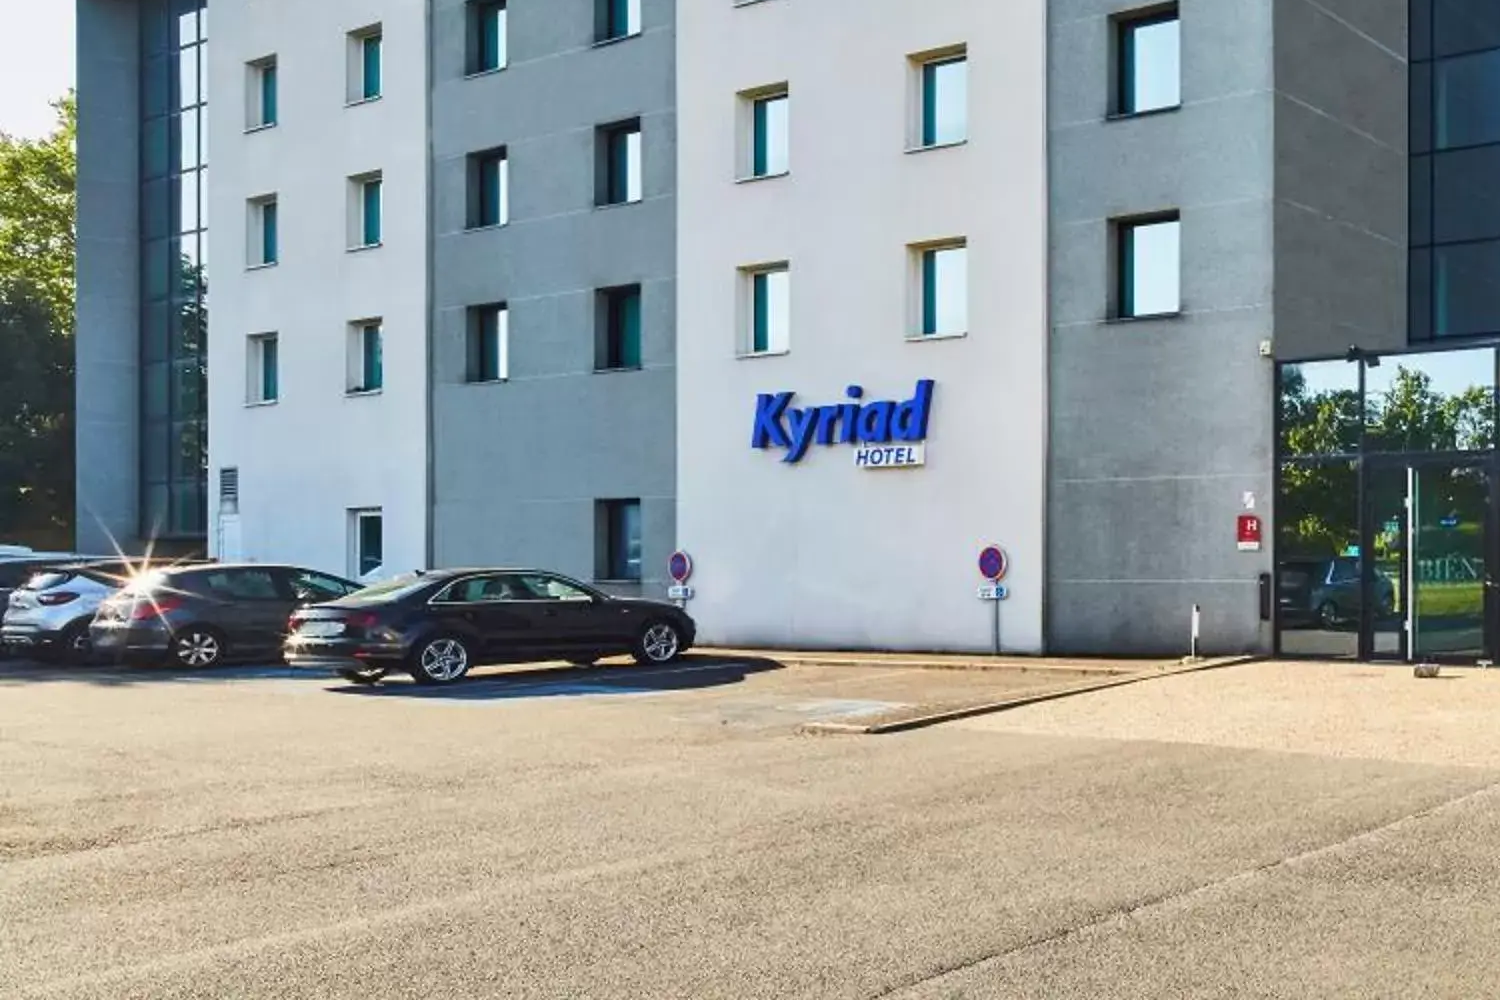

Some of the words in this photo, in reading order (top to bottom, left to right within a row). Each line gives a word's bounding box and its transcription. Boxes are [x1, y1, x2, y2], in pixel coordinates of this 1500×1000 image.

[752, 379, 935, 463] Kyriad
[856, 448, 916, 465] HOTEL
[1247, 519, 1257, 531] H
